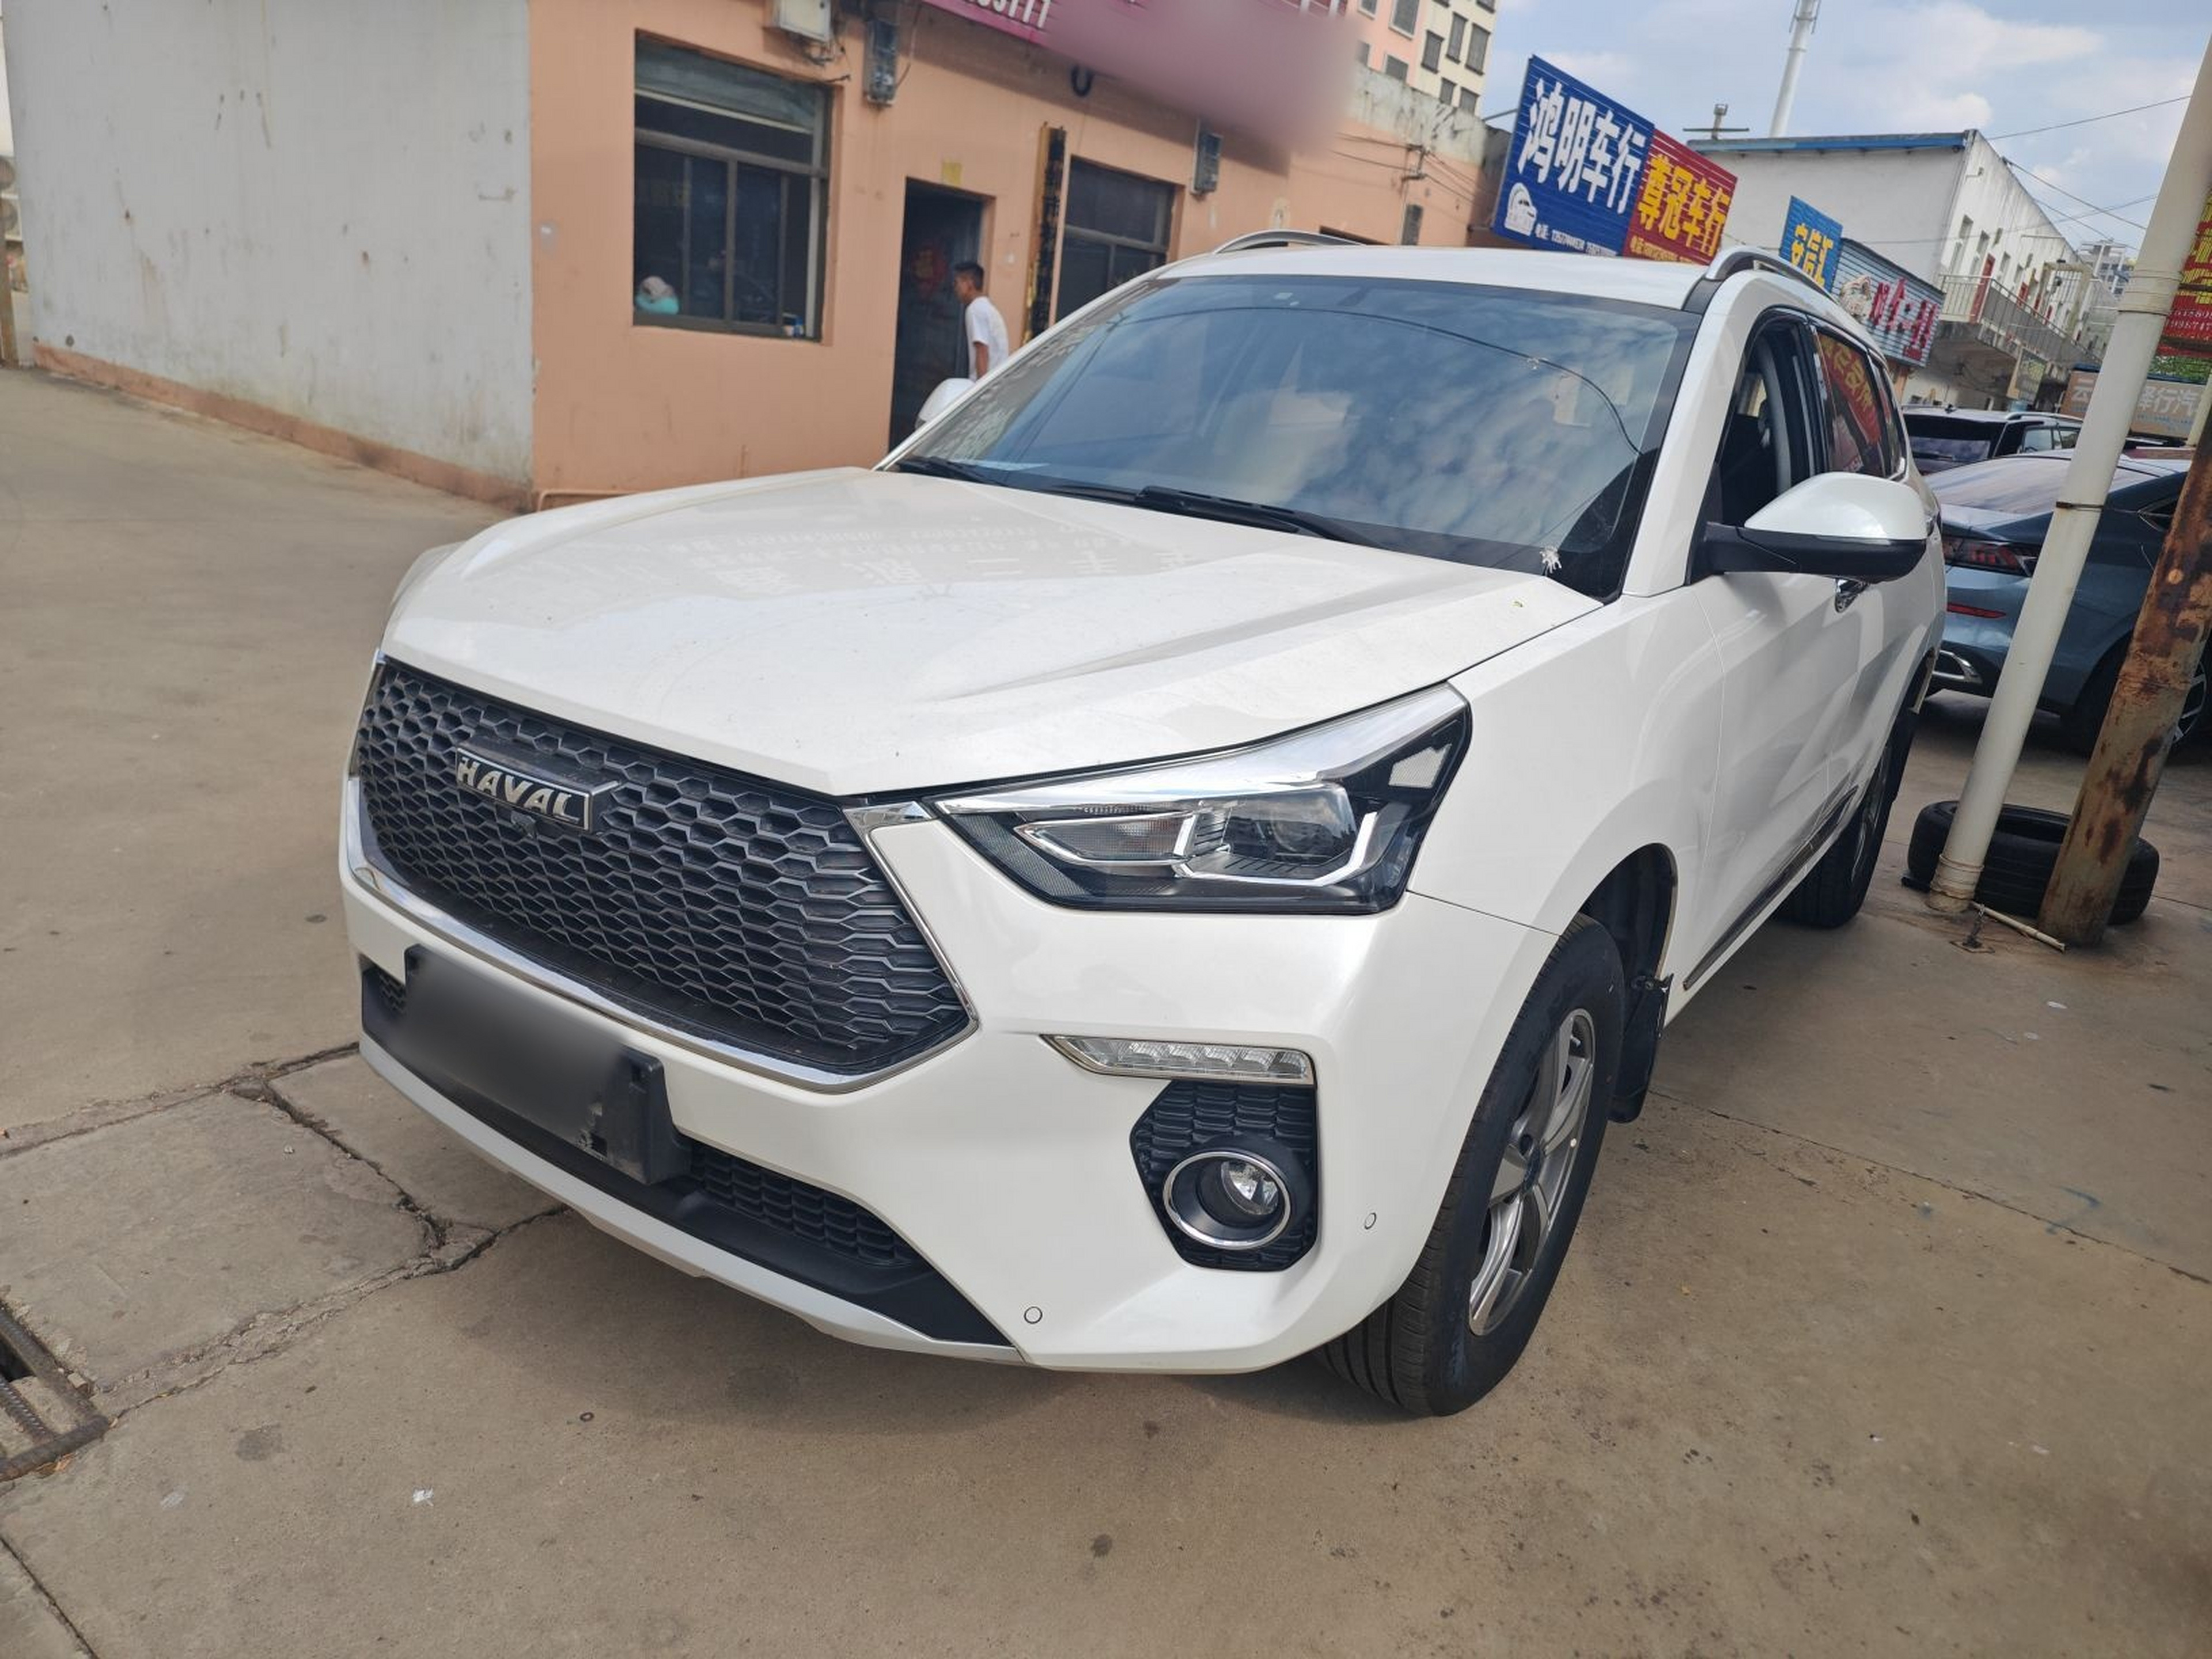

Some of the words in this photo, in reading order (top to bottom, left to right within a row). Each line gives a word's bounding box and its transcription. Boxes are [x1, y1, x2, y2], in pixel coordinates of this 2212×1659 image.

[1518, 77, 1646, 214] 鸿明车行
[1638, 153, 1730, 256] 尊冠车行
[457, 756, 580, 824] HAVAL
